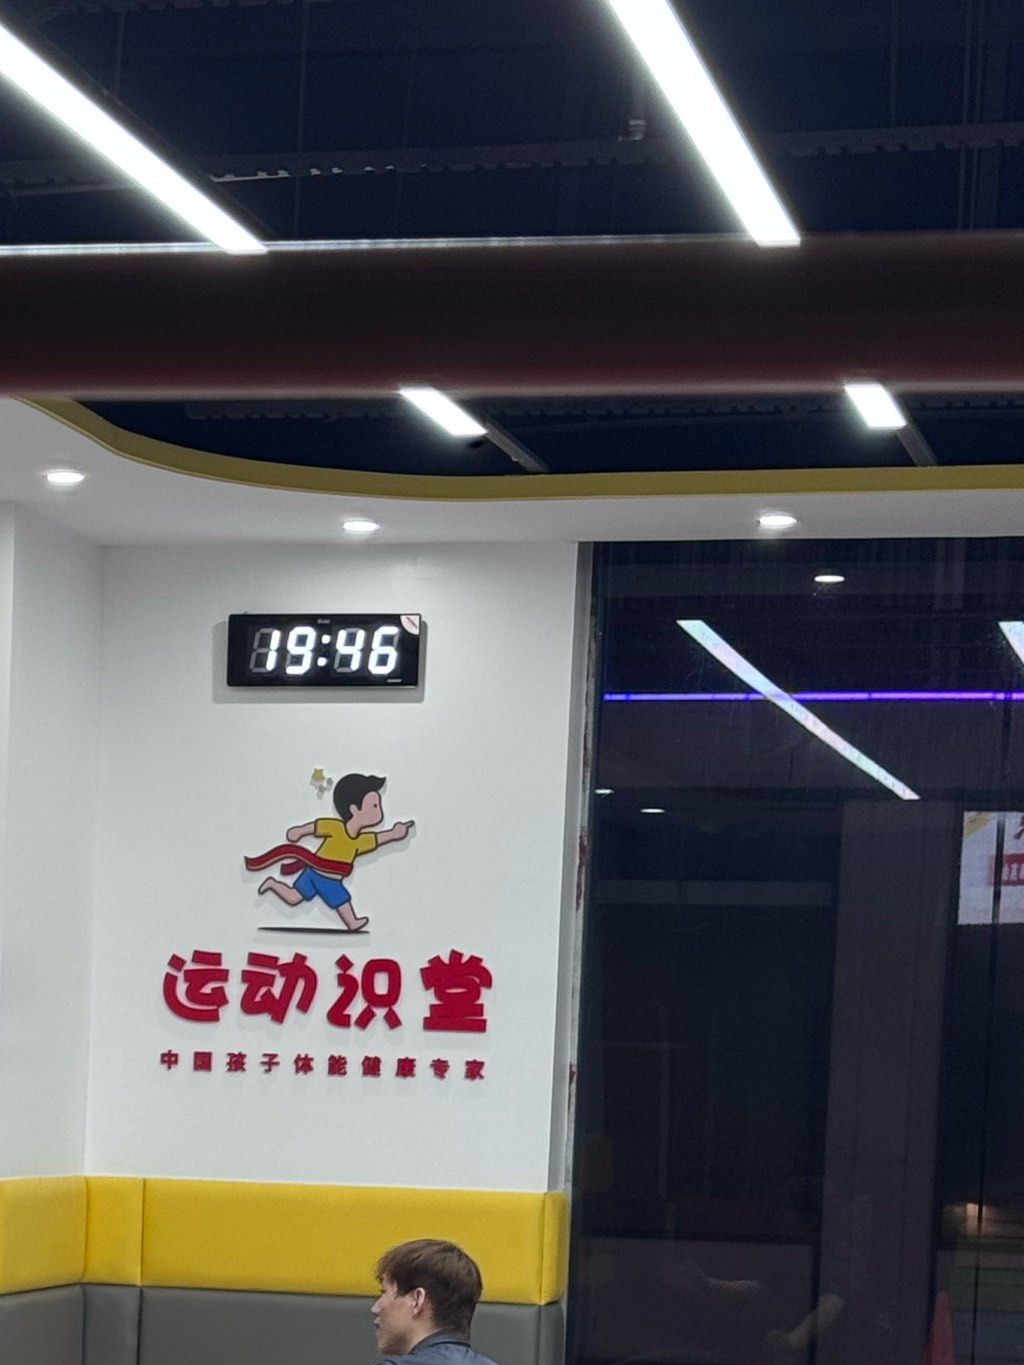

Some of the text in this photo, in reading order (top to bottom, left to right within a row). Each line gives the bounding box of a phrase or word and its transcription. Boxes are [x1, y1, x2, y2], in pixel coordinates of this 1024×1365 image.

[264, 625, 400, 676] 19:46
[162, 948, 493, 1033] 运动识堂
[160, 1049, 486, 1081] 中国孩子体能健康专家
